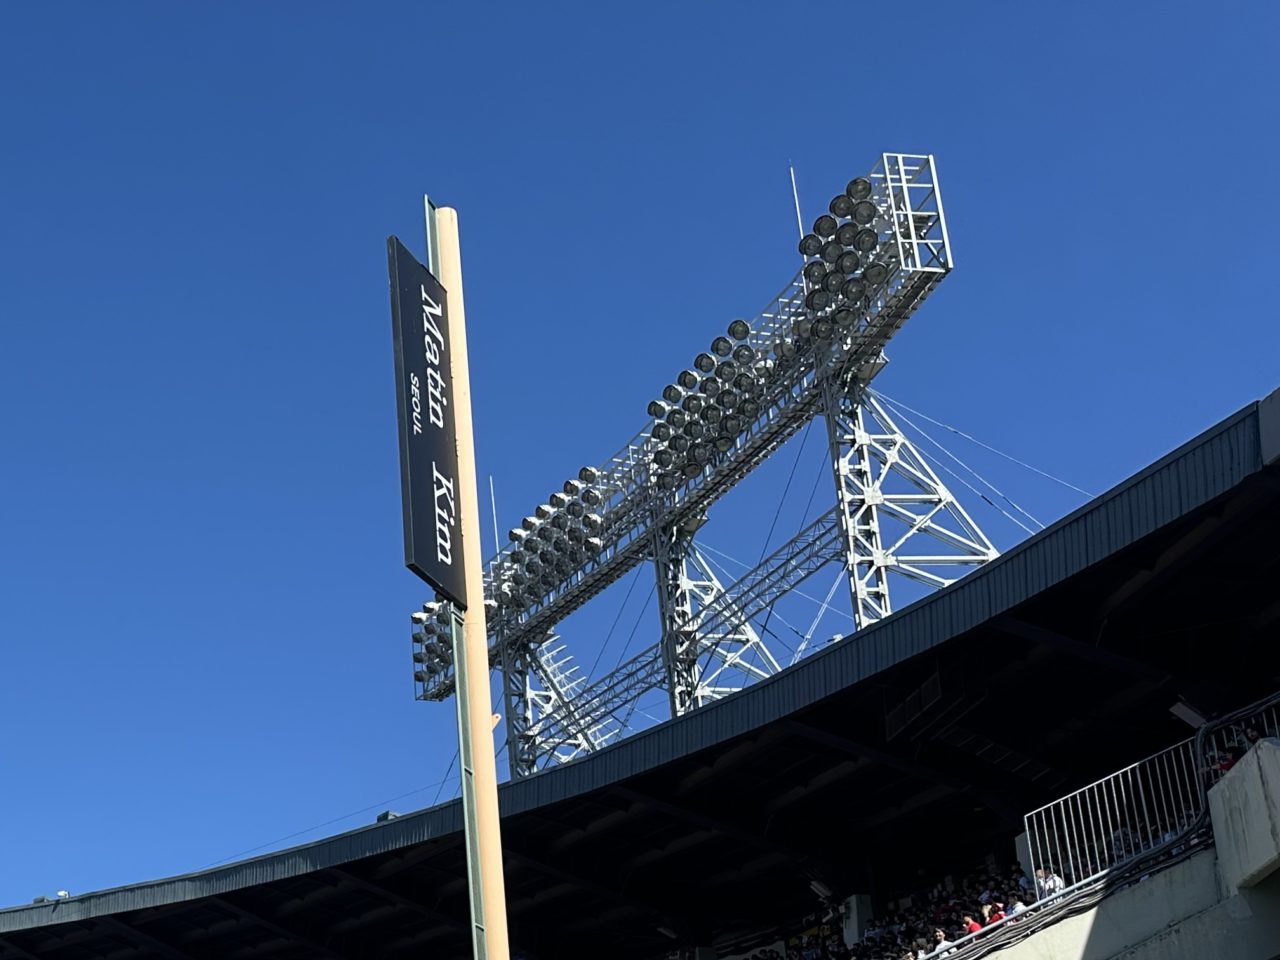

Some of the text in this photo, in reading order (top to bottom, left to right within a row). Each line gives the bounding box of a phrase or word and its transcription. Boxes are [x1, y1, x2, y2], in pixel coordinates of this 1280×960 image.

[410, 372, 423, 435] SEOUL
[420, 285, 454, 566] Matin Kim
